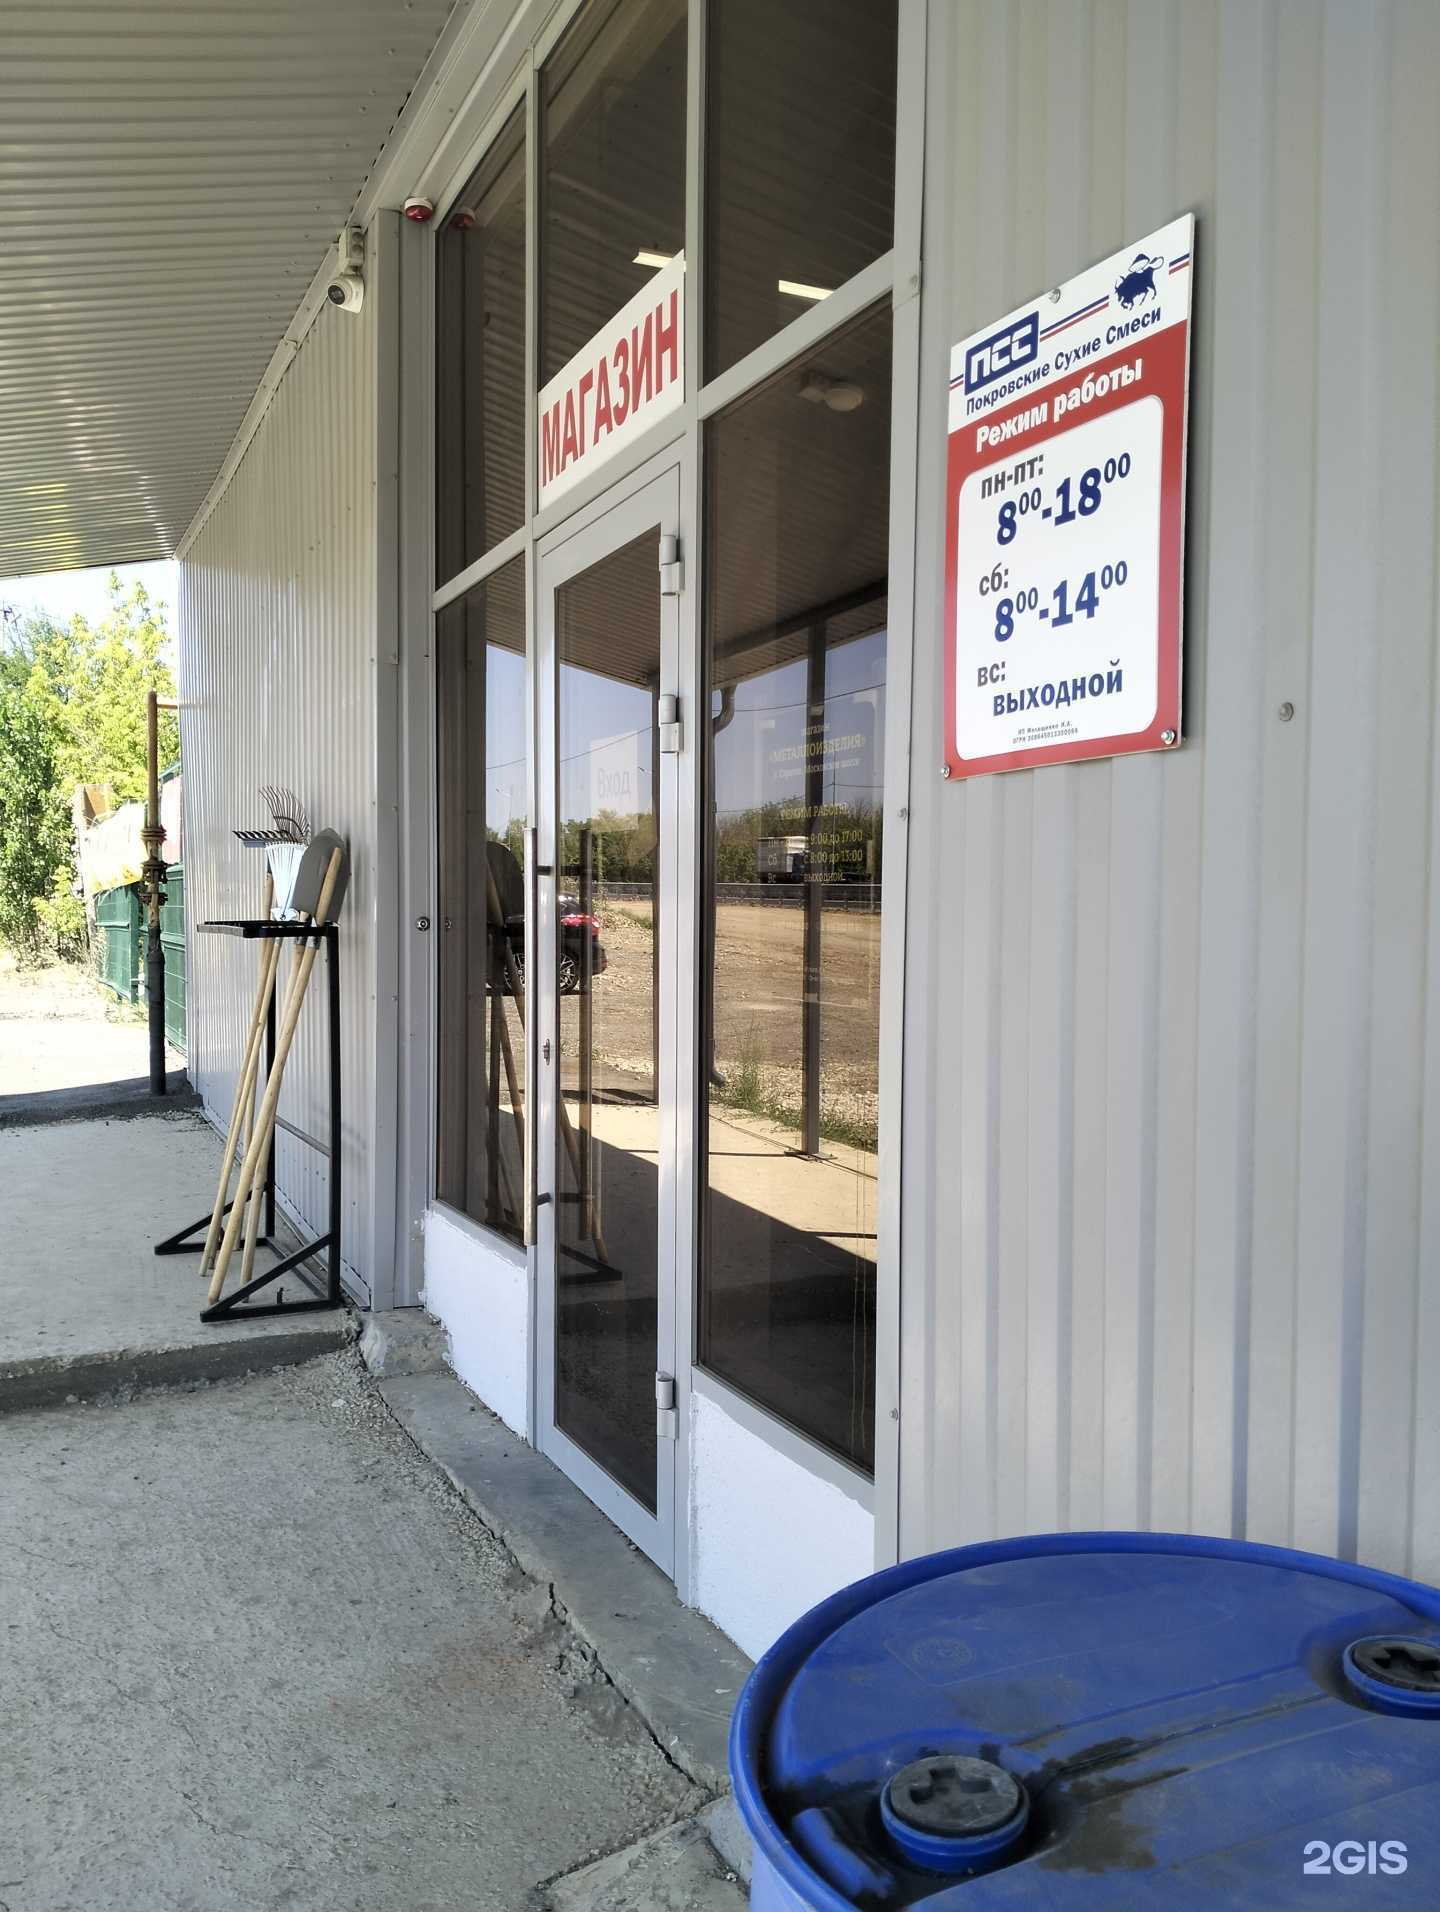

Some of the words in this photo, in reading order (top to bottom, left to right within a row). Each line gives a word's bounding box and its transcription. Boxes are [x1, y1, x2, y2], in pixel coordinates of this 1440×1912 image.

[542, 288, 678, 488] МАГАЗИН
[966, 361, 1050, 416] Покровские
[1054, 336, 1101, 371] Сухие
[1106, 306, 1162, 345] Смеси
[975, 401, 1048, 453] Режим
[1053, 358, 1143, 423] работы
